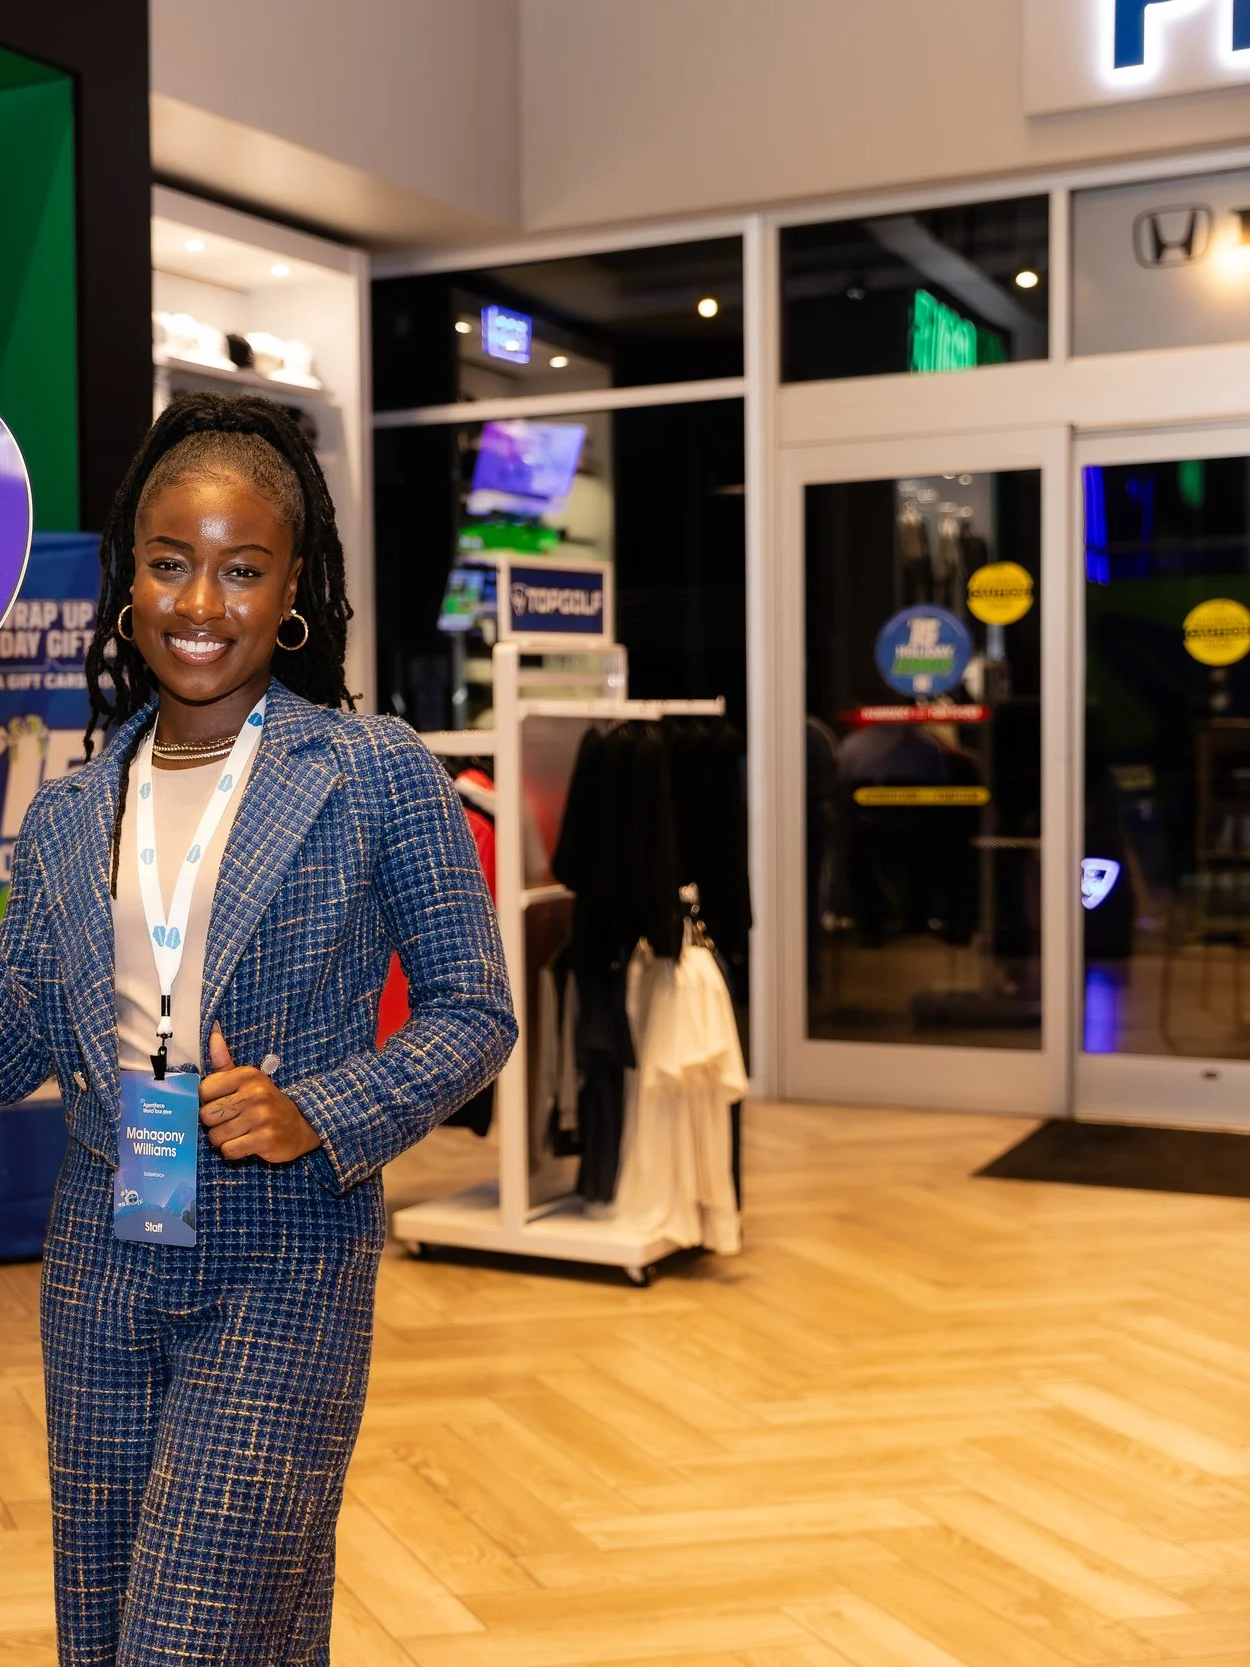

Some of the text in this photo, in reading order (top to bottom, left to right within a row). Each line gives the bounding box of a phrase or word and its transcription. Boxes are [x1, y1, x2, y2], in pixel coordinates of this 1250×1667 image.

[527, 586, 602, 616] TOPGOLF
[62, 601, 94, 629] UP
[126, 1126, 185, 1144] Mahagony
[133, 1142, 177, 1158] Williams
[144, 1221, 164, 1233] Staff
